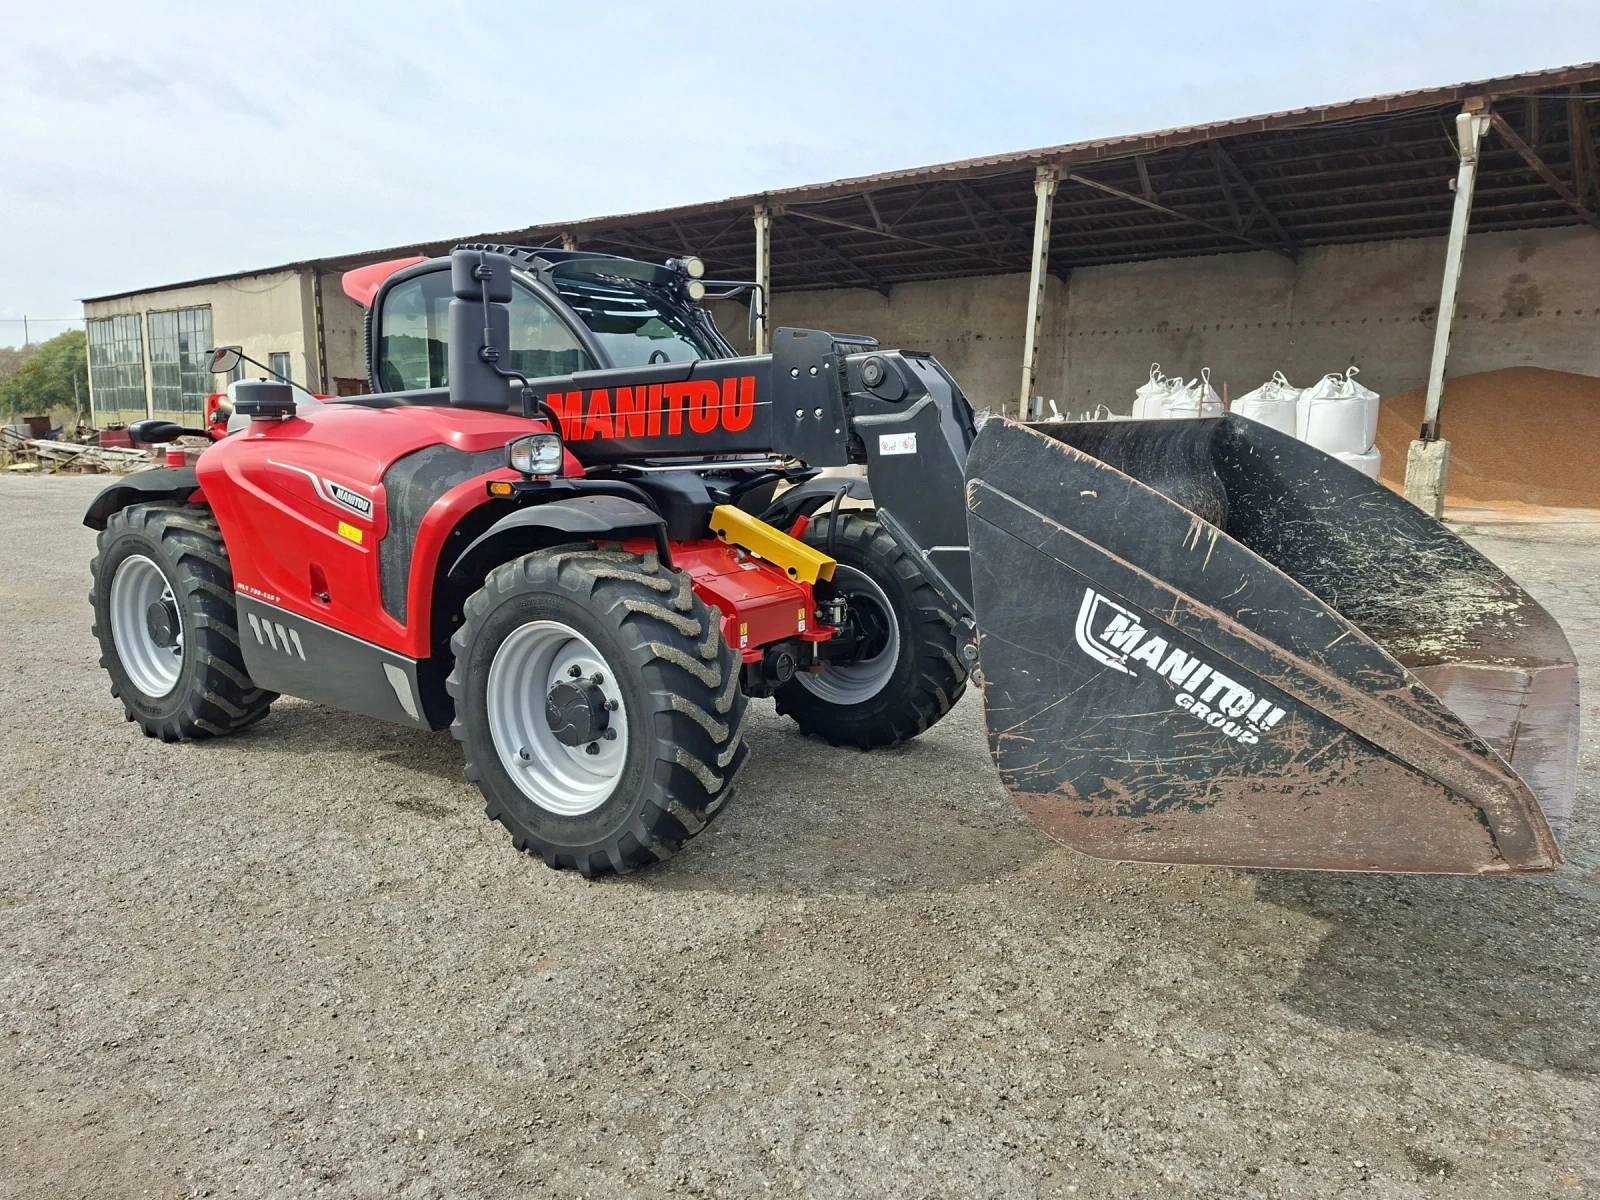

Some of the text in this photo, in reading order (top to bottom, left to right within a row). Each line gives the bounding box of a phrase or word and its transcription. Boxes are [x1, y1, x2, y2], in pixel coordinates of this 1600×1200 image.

[546, 376, 756, 441] MANITOU
[336, 488, 369, 512] MANITOU
[237, 582, 249, 592] MLT
[1099, 613, 1287, 732] MANITOU
[1174, 692, 1260, 745] GROUP
